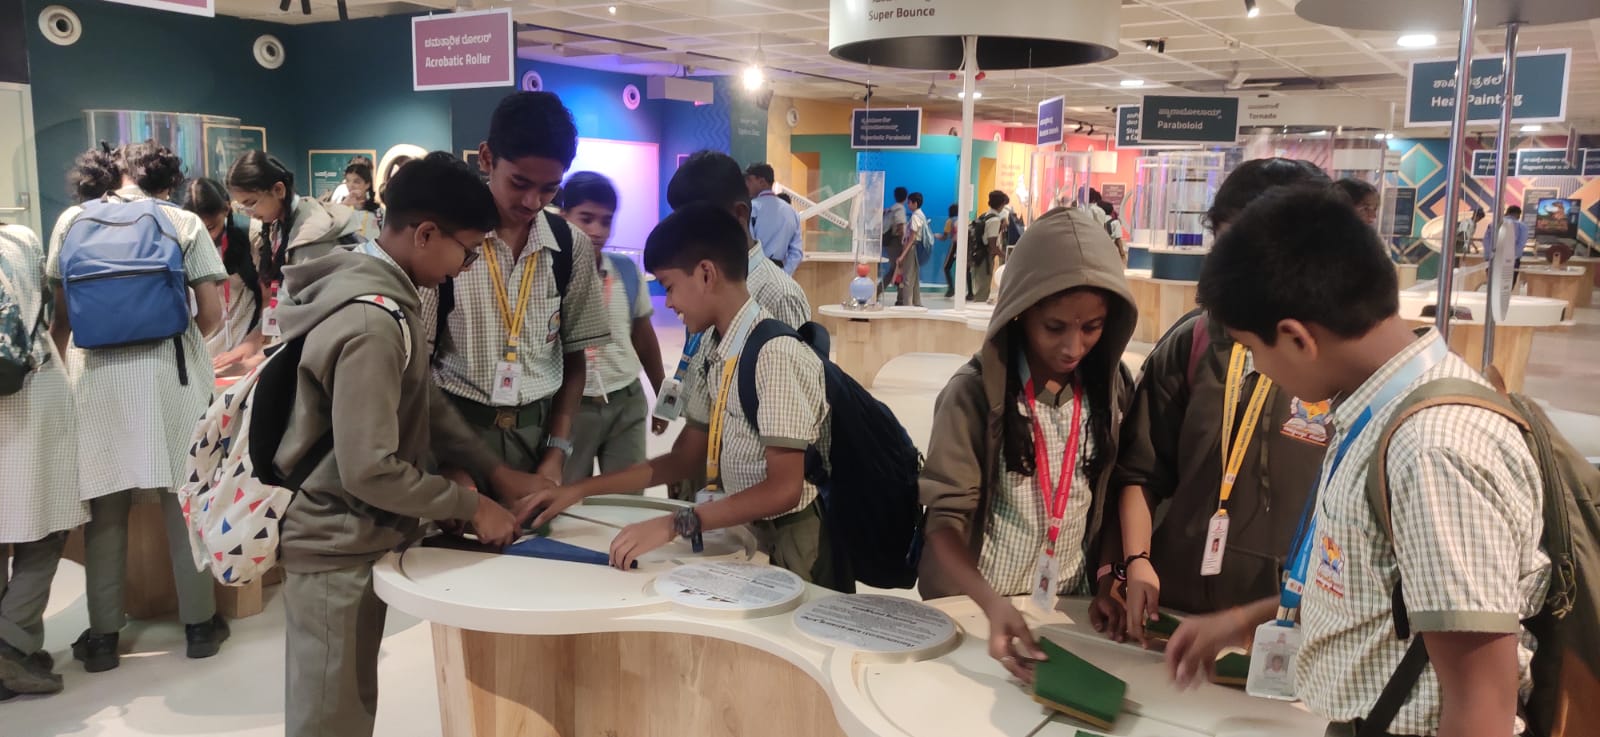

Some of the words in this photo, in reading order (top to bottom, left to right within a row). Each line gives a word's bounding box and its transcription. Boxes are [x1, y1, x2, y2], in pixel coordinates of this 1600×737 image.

[868, 10, 894, 22] Super
[896, 7, 936, 18] Bounce
[425, 54, 464, 68] Acrobatic
[465, 53, 491, 65] Roller
[1431, 96, 1456, 107] Hea
[1466, 93, 1524, 107] Paintg
[1157, 120, 1204, 130] Paraboloid
